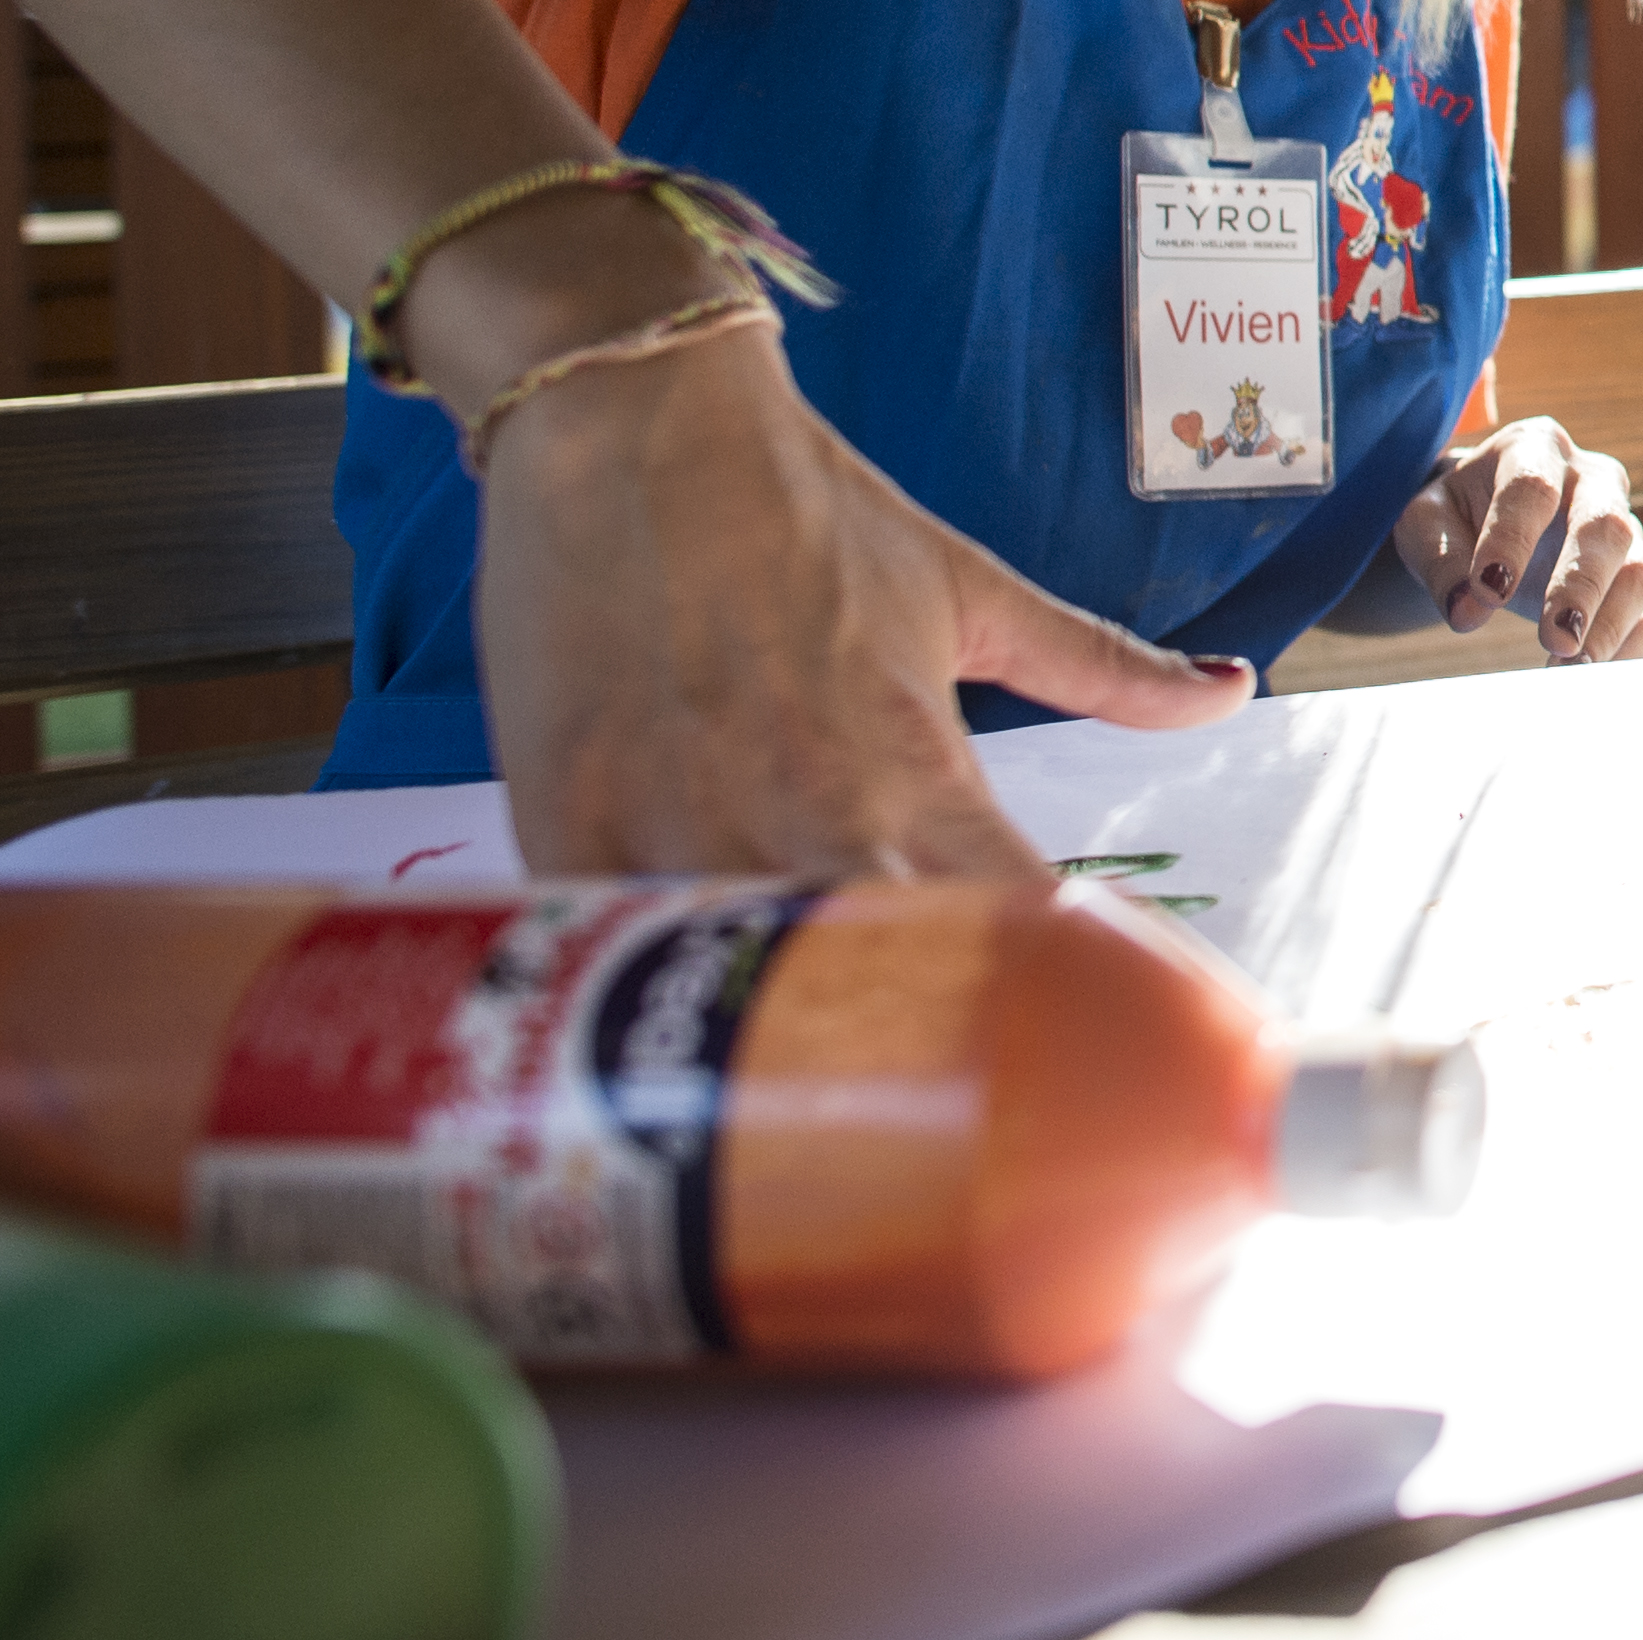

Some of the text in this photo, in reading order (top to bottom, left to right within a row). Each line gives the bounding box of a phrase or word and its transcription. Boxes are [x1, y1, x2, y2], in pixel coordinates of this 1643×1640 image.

[1155, 203, 1297, 233] TYROL
[1201, 240, 1247, 249] WELLNESS
[1164, 298, 1301, 345] Vivien
